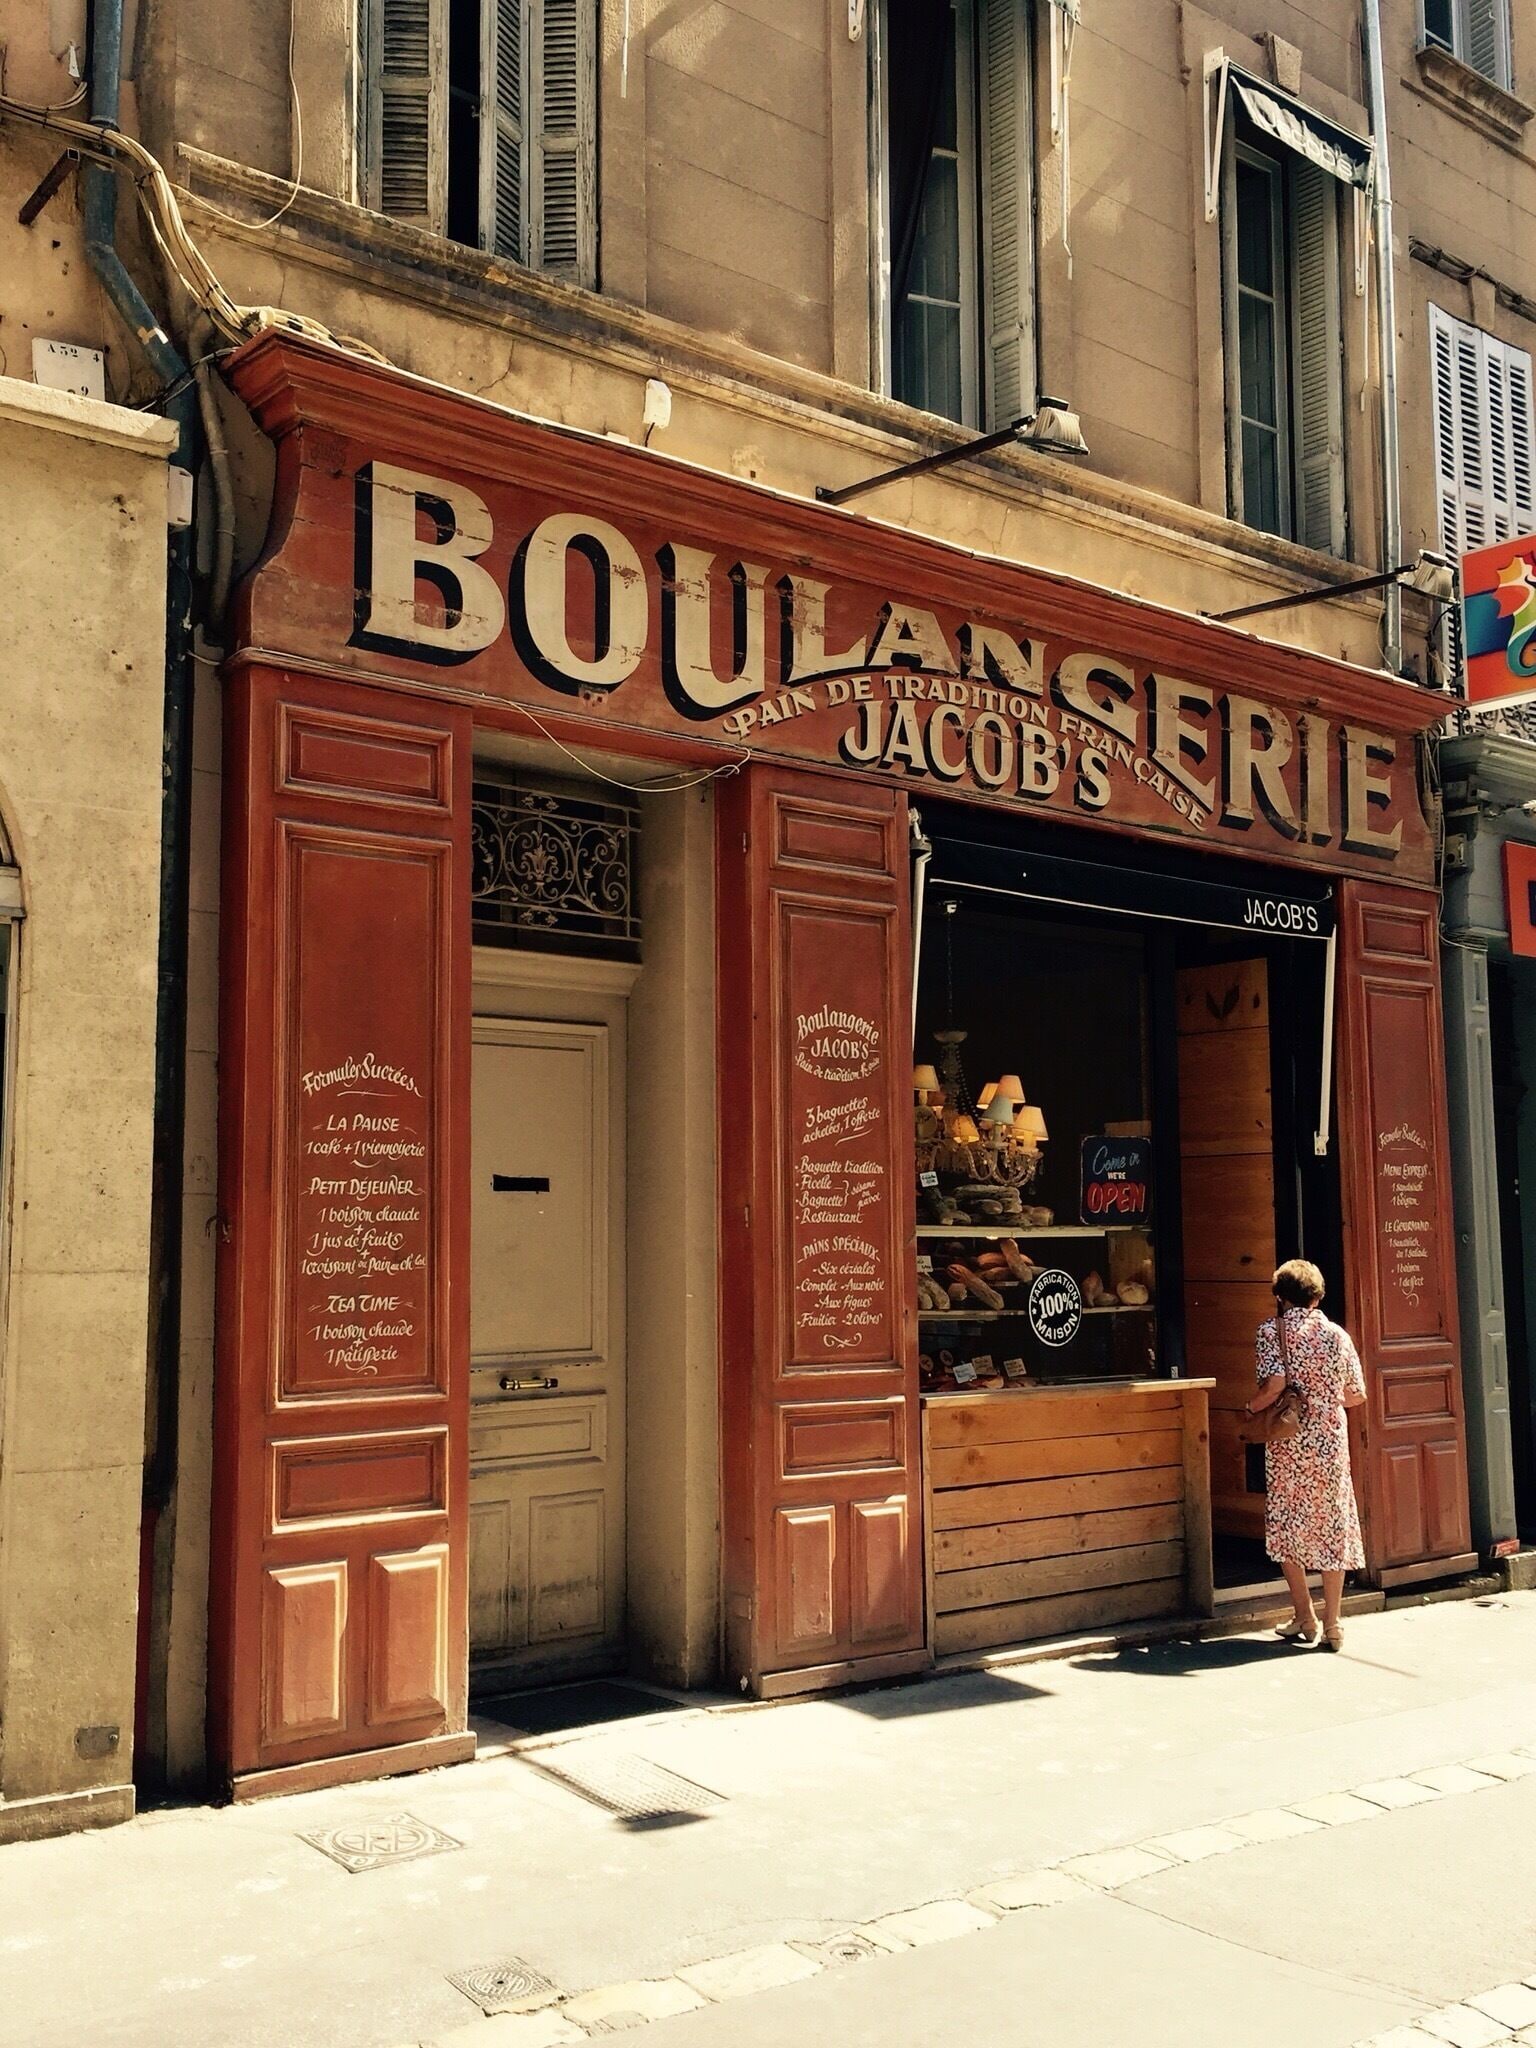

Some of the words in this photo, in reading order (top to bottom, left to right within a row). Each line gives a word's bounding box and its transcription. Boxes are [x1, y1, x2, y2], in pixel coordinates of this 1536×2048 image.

[350, 461, 1404, 858] BOULANGERIE
[723, 687, 816, 739] PAIN
[826, 676, 874, 706] DE
[884, 676, 1050, 727] TRADITION
[1060, 711, 1208, 832] FRANÇAISE
[841, 700, 1112, 811] JACOB'S
[1244, 898, 1318, 931] JACOB'S
[797, 1004, 879, 1045] Boulangerie
[811, 1037, 869, 1060] JACOB'S
[362, 1052, 415, 1091] Sucrées
[327, 1114, 346, 1131] LA
[352, 1114, 399, 1131] PAUSE
[800, 1155, 842, 1175] Baguette
[1093, 1145, 1126, 1175] Come
[309, 1177, 347, 1195] PETIT
[801, 1174, 832, 1190] Ficelle
[799, 1191, 843, 1209] Baguette
[1087, 1182, 1146, 1213] OPEN
[376, 1205, 419, 1221] chaude
[800, 1207, 864, 1224] Restaurant
[345, 1233, 359, 1247] de
[357, 1228, 405, 1252] fruits
[1031, 1274, 1078, 1303] FABRICATION
[325, 1295, 355, 1313] TEA
[359, 1295, 399, 1312] TIME
[1039, 1293, 1073, 1319] 100%
[369, 1319, 416, 1336] chaude
[1036, 1313, 1078, 1340] MAISON
